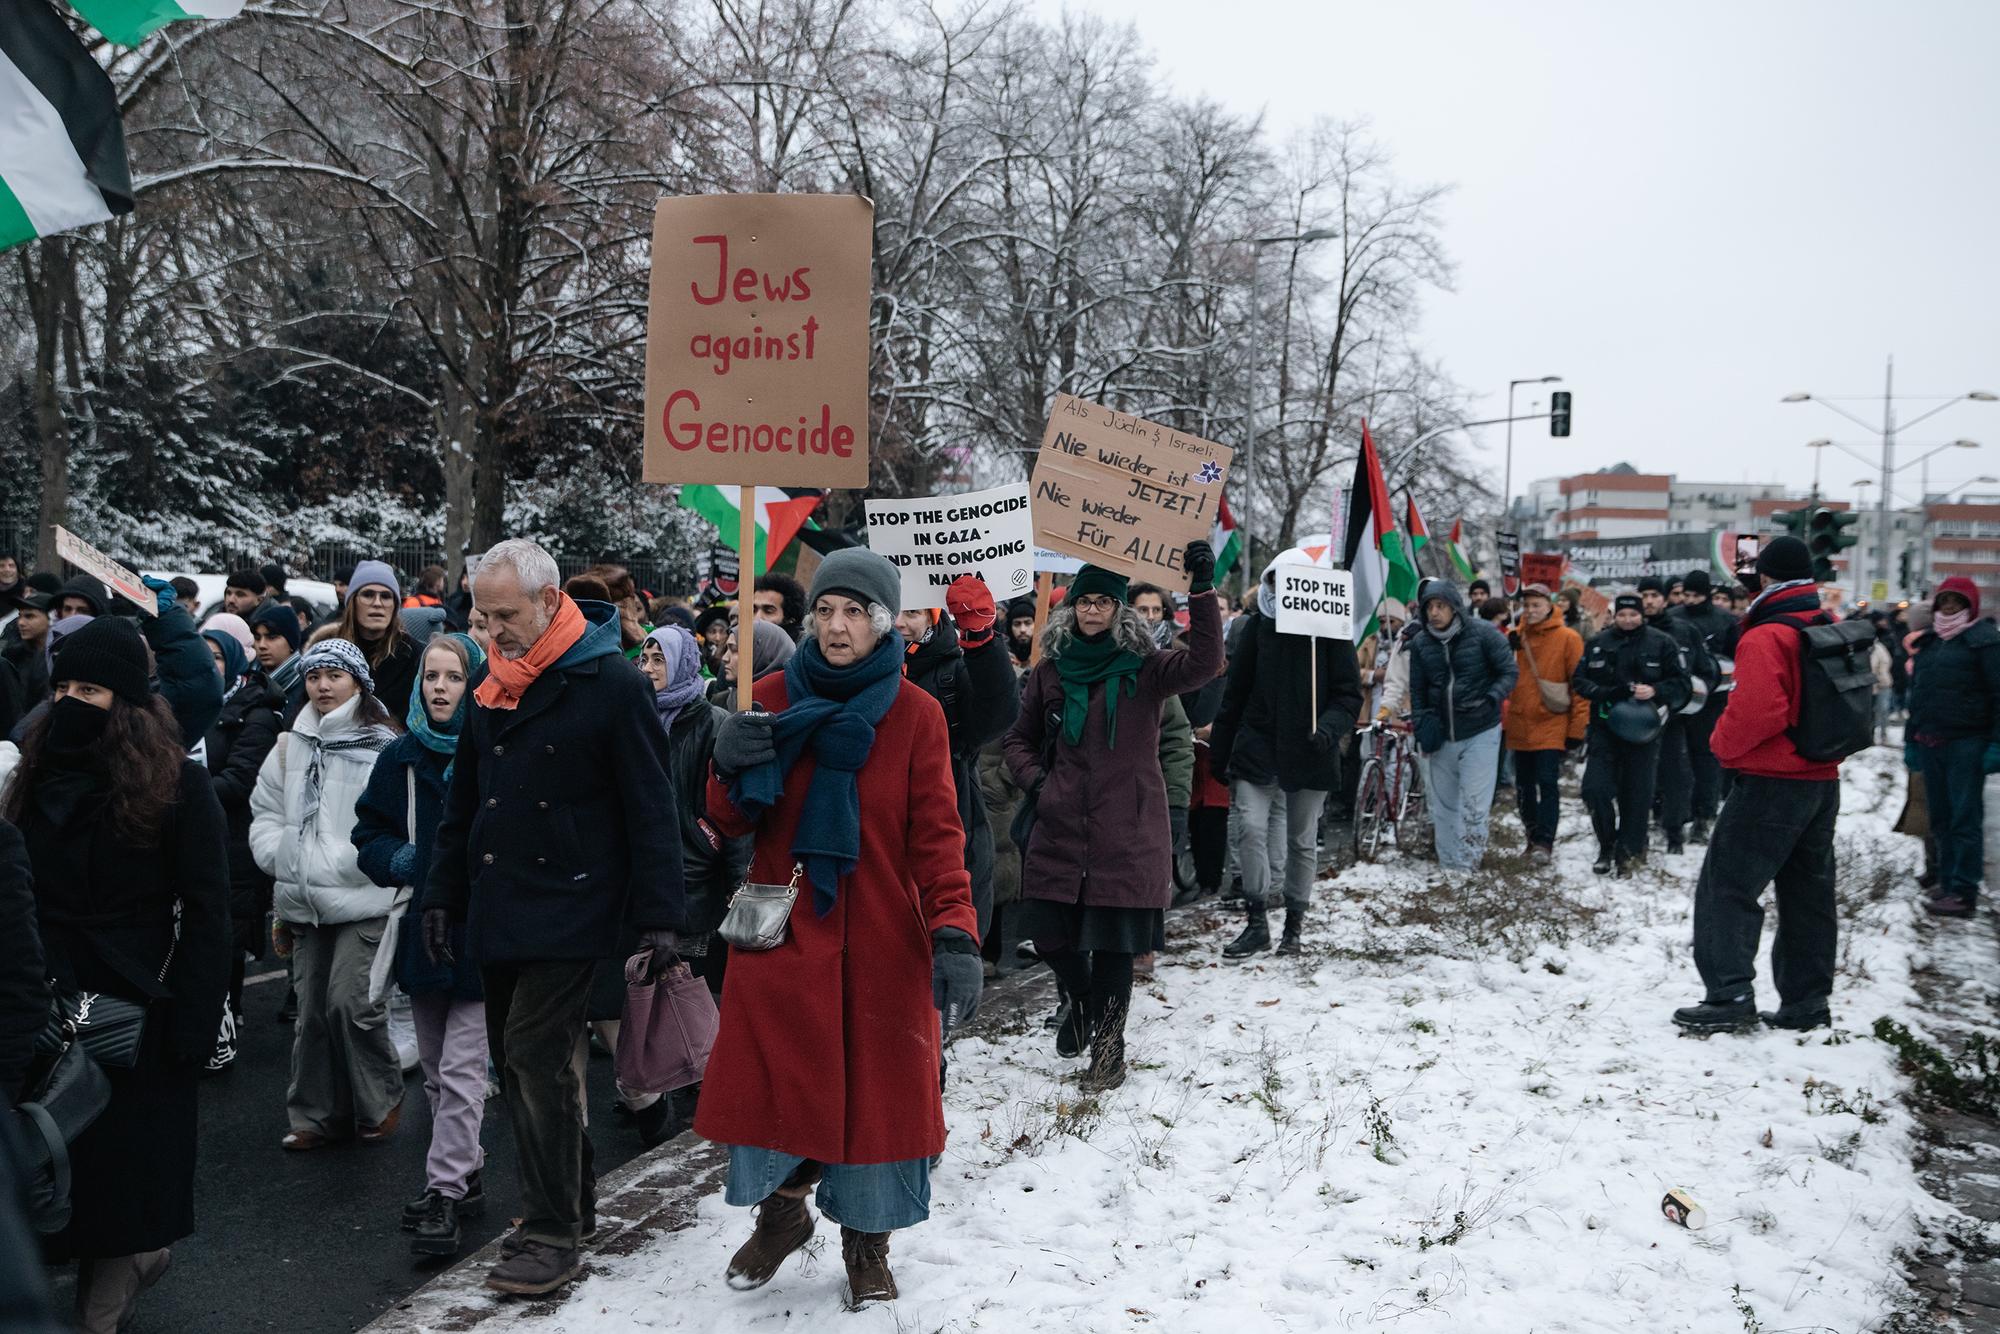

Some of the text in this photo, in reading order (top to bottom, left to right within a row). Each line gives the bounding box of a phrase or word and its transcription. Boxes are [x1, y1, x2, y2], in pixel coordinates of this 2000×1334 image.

[691, 234, 811, 305] Jews
[690, 315, 819, 375] against
[663, 389, 855, 458] Genocide
[1063, 399, 1089, 418] Als
[1103, 410, 1147, 437] Jüdin
[1169, 433, 1213, 458] Israeli
[1053, 431, 1190, 488] Nie wieder ist
[869, 495, 1028, 526] STOP THE GENOCIDE
[1036, 480, 1142, 526] Nie wieder
[914, 532, 931, 546] IN
[935, 527, 981, 545] GAZA
[1077, 520, 1117, 549] Für
[883, 539, 1026, 567] ND THE ONGOING
[929, 570, 986, 586] NAKA
[1286, 577, 1346, 597] STOP THE
[1282, 596, 1351, 616] GENOCIDE
